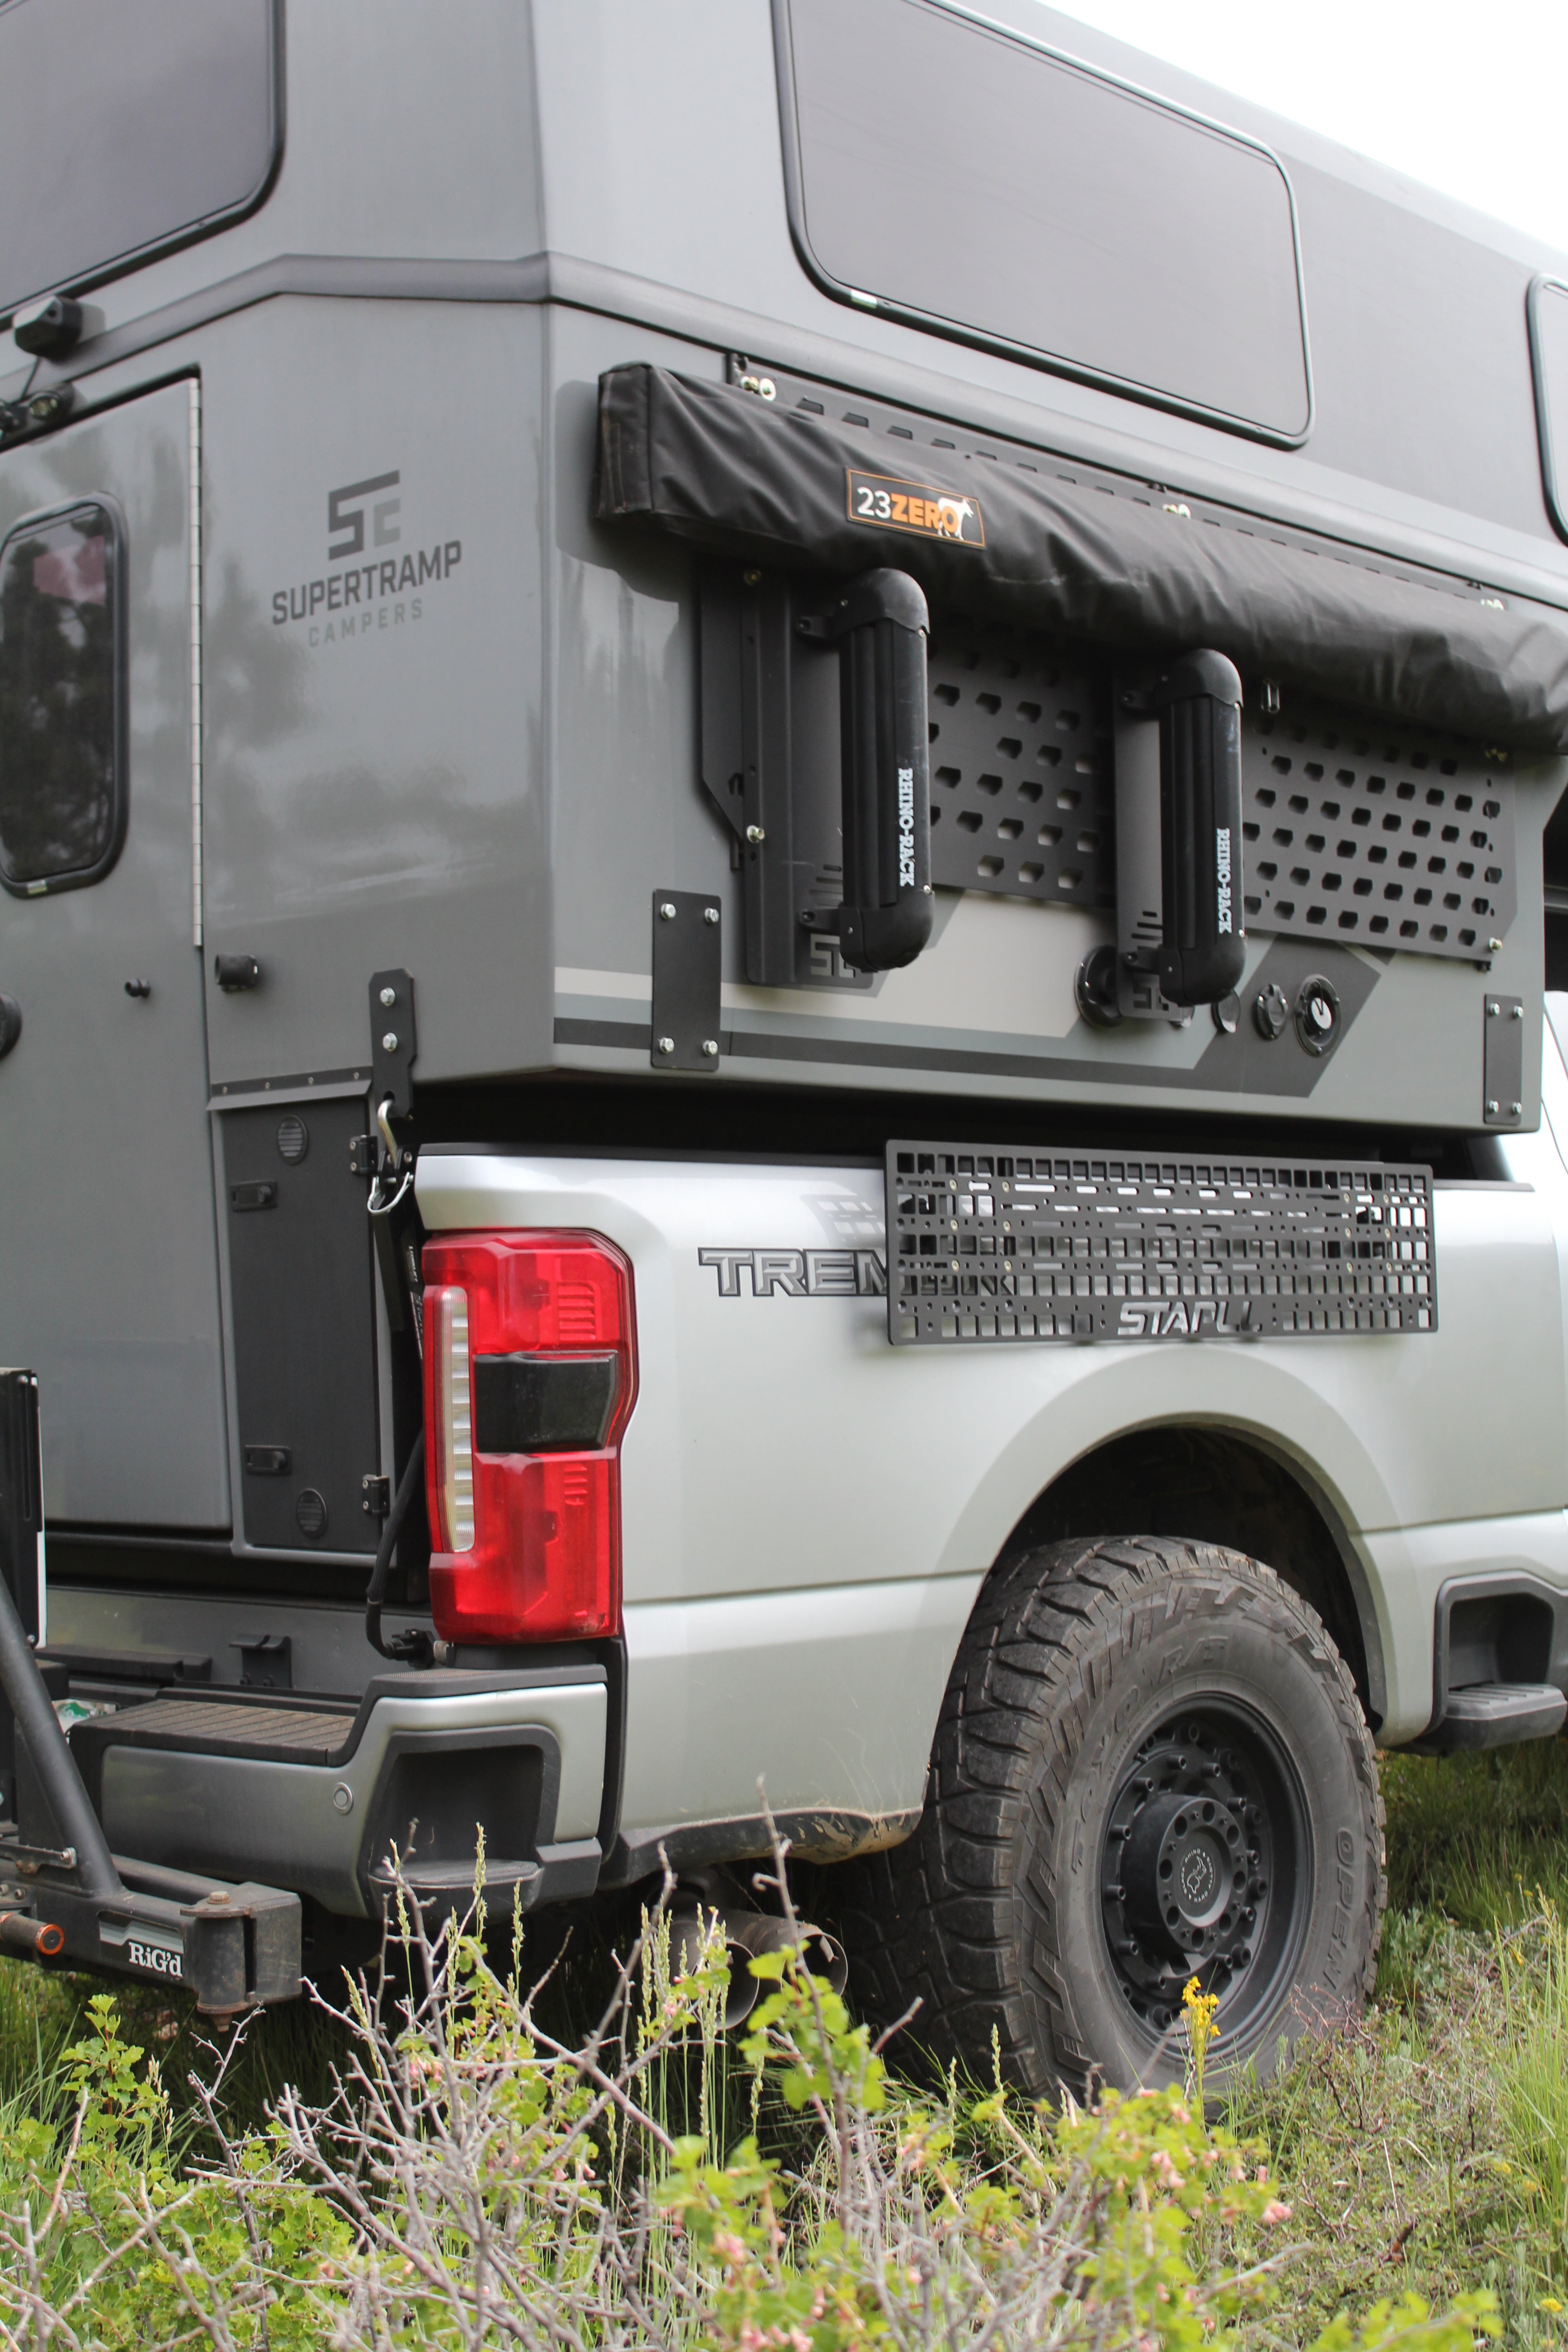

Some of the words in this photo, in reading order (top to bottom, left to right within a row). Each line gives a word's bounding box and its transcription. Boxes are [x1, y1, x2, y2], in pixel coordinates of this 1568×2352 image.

[857, 486, 959, 534] 23ZERO
[273, 540, 462, 625] SUPERTRAMP
[309, 598, 422, 648] CAMPERS
[898, 767, 915, 887] RHINO-RACK
[1216, 827, 1232, 933] RHINO-RACK
[1185, 1848, 1200, 1863] RHINO
[1194, 1890, 1208, 1902] HARD
[1323, 1818, 1354, 1990] OPEN
[128, 1941, 183, 1977] RiG'd
